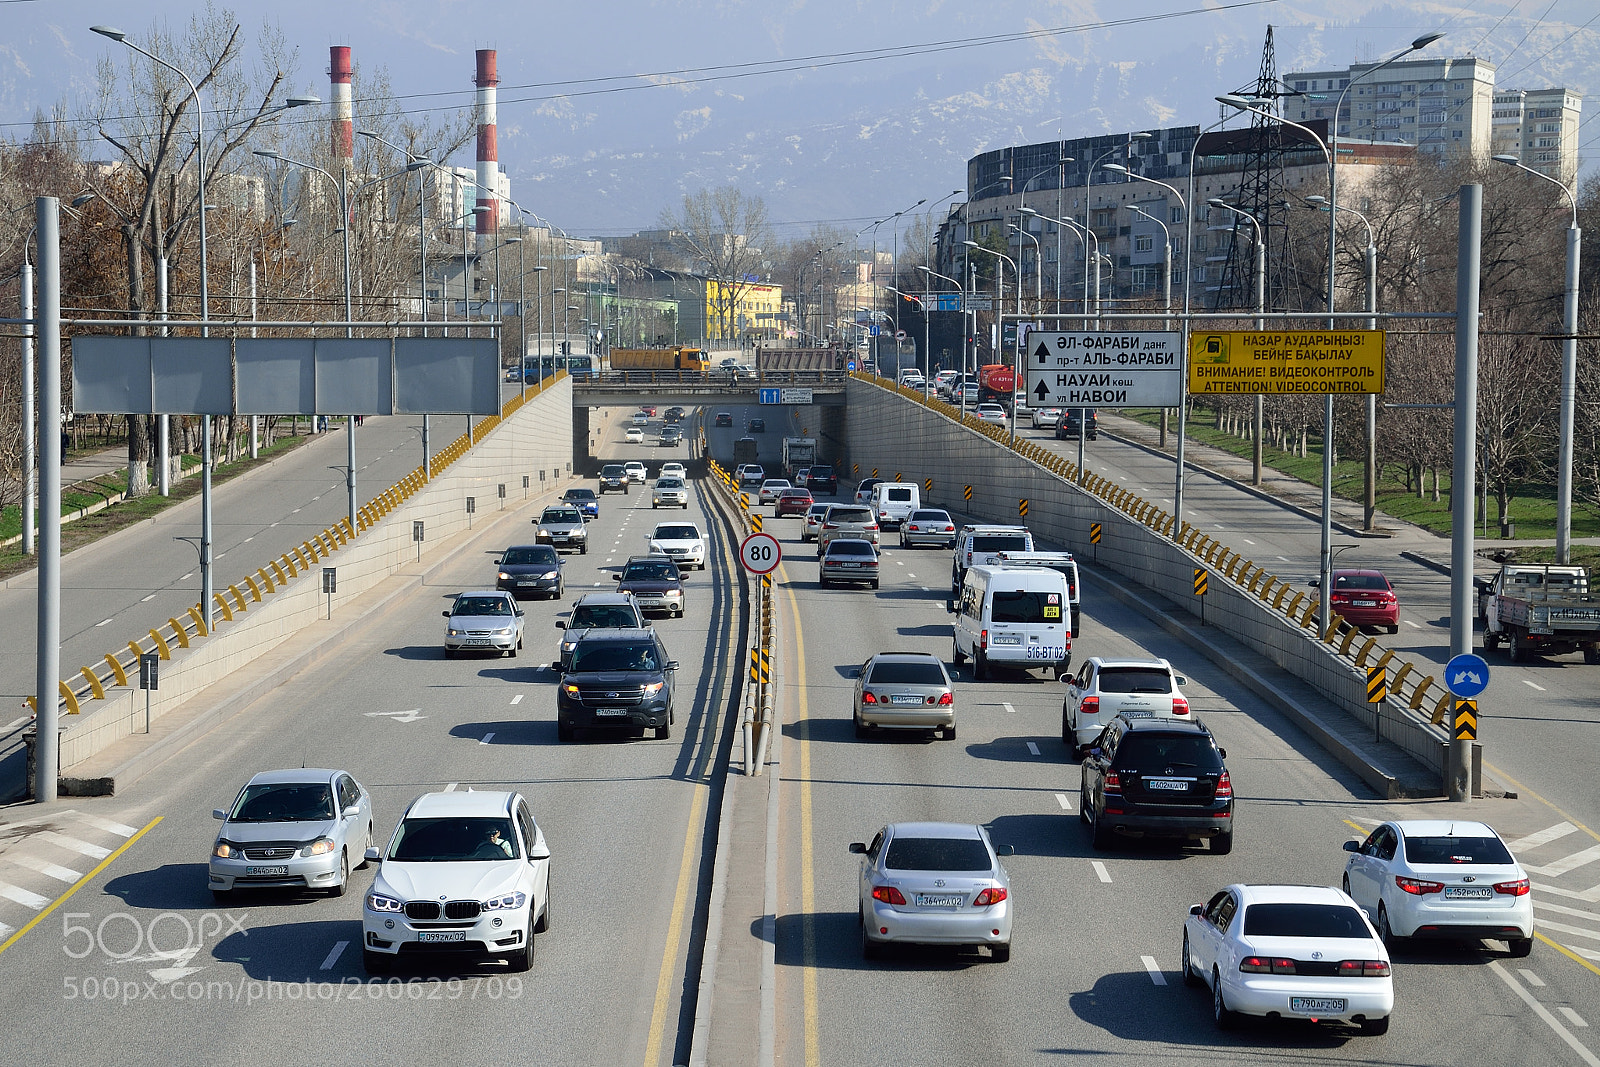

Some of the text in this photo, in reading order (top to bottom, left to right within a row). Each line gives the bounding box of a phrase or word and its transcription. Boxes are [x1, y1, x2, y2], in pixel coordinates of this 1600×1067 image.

[1057, 337, 1139, 349] ӘЛ-ФАРАБИ
[1243, 335, 1365, 348] НАЗАР АУДАРЫҢЫЗ!
[1057, 352, 1174, 367] пр-т АЛЬ-ФАРАБИ
[1254, 348, 1353, 362] БЕЙНЕ БАҚЫЛАУ
[1197, 367, 1375, 379] ВНИМАНИЕ! ВИДЕОКОНТРОЛЬ
[1057, 374, 1110, 387] НАУАИ
[1204, 381, 1366, 392] ATTENTION! VIDEOCONTROL
[1070, 390, 1127, 403] НАВОИ
[751, 546, 771, 561] 80
